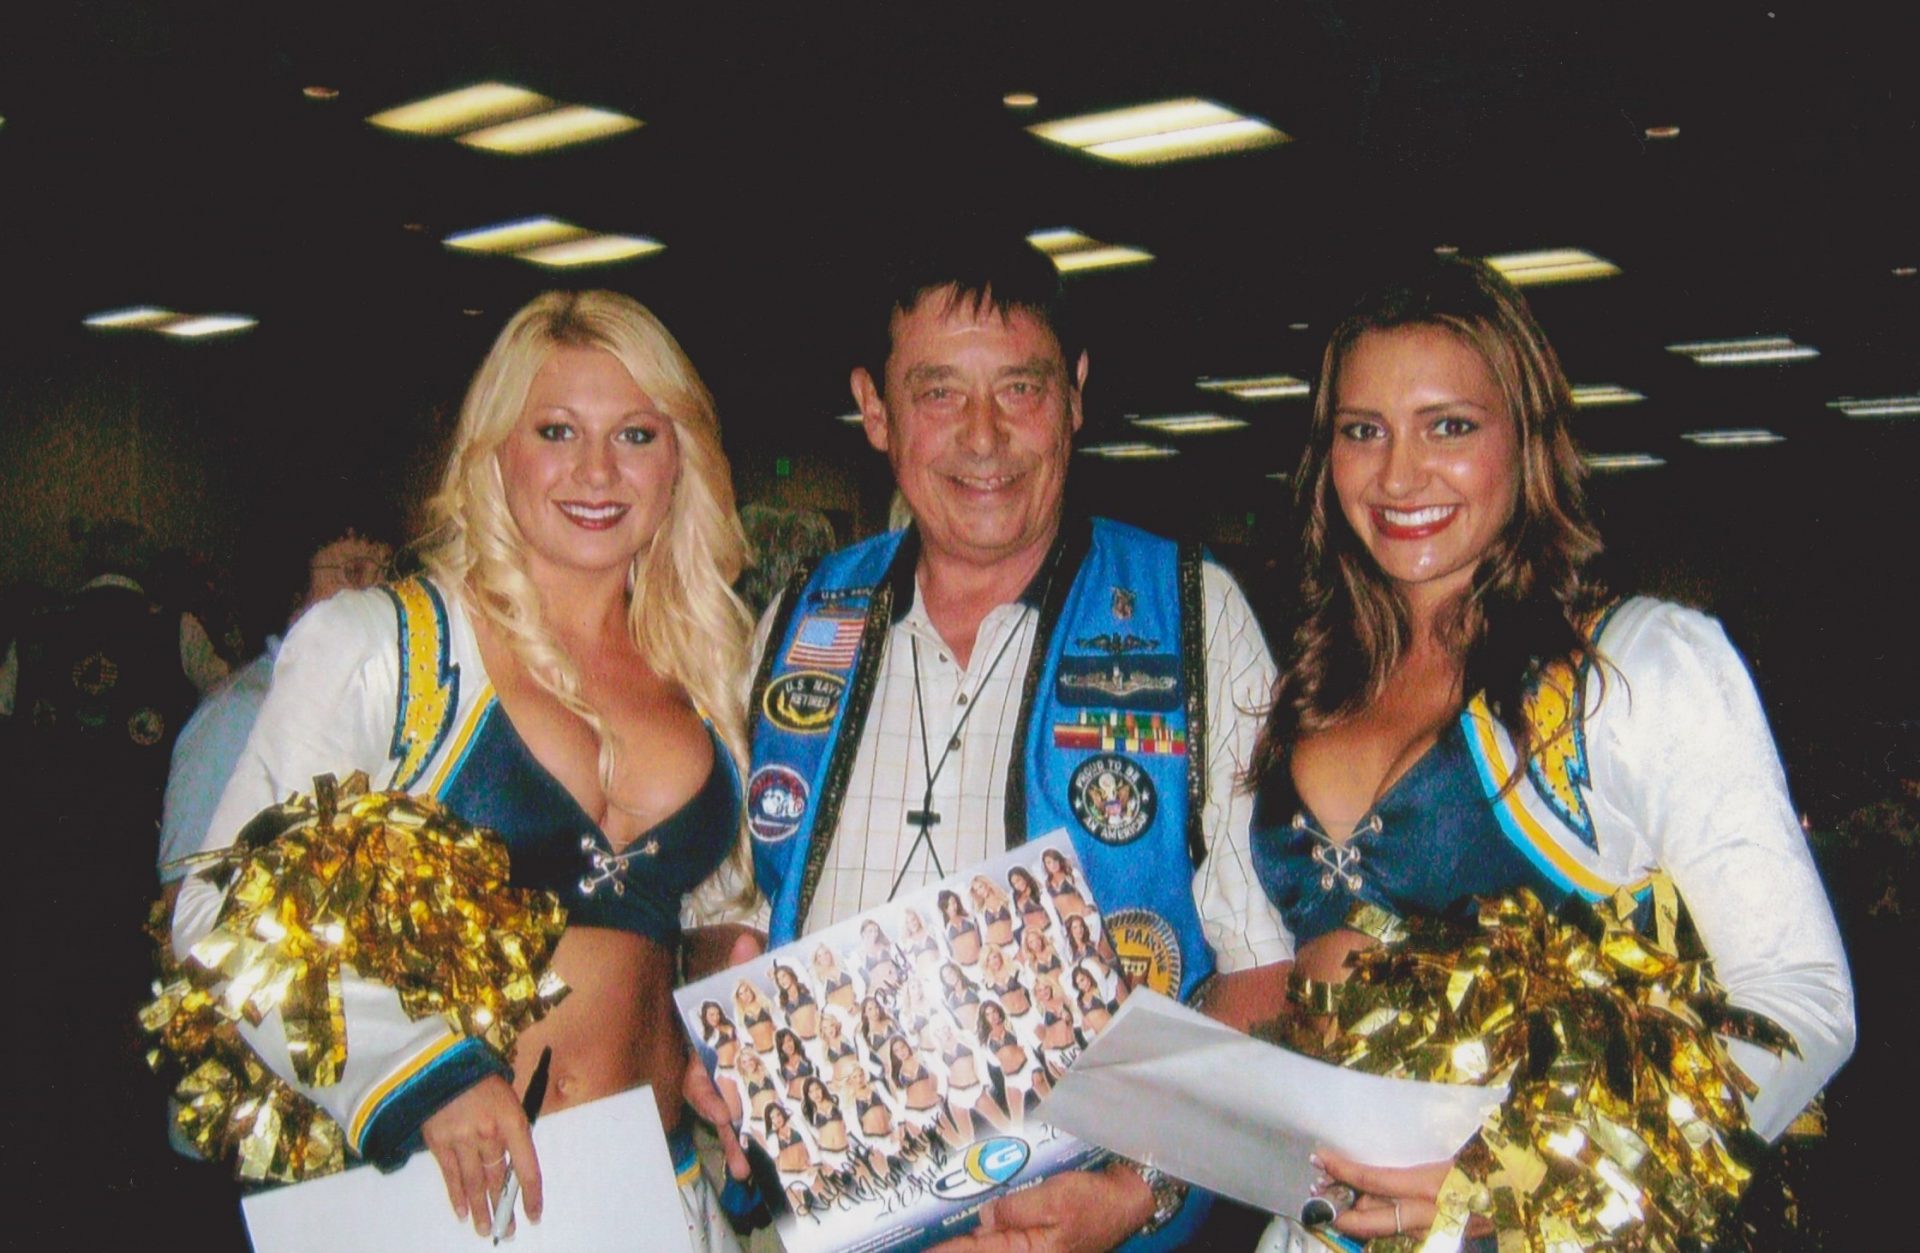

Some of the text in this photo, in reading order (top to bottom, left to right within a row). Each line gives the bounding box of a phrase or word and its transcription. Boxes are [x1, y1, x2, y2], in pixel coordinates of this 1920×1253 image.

[789, 692, 831, 708] RETIRED
[813, 679, 842, 698] NAVY
[1075, 758, 1141, 788] PROUD TO BE
[1083, 811, 1149, 840] AN AMERICAN
[1124, 927, 1169, 975] PARCHE
